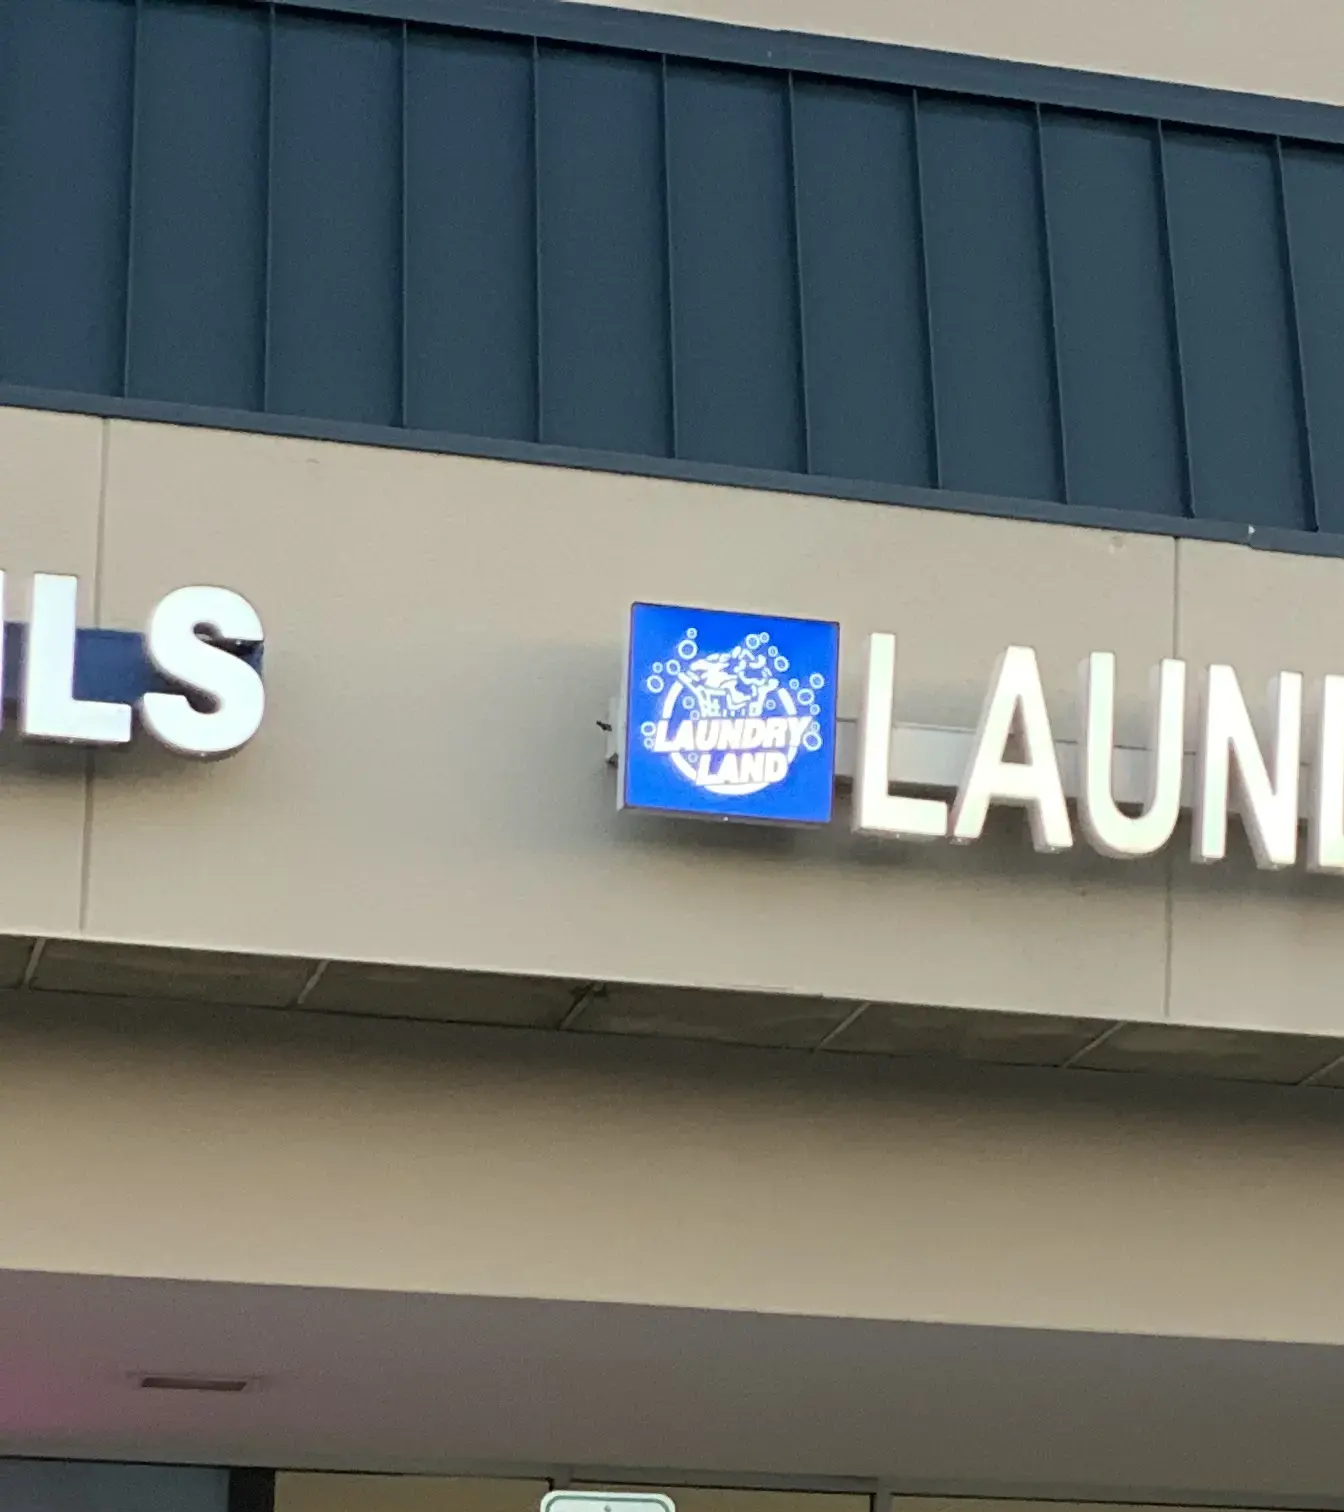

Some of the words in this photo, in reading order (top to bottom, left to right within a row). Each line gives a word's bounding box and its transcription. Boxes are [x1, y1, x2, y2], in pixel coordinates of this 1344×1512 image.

[0, 570, 266, 757] LS
[652, 714, 814, 752] LAUNDRY
[695, 750, 789, 786] LAND
